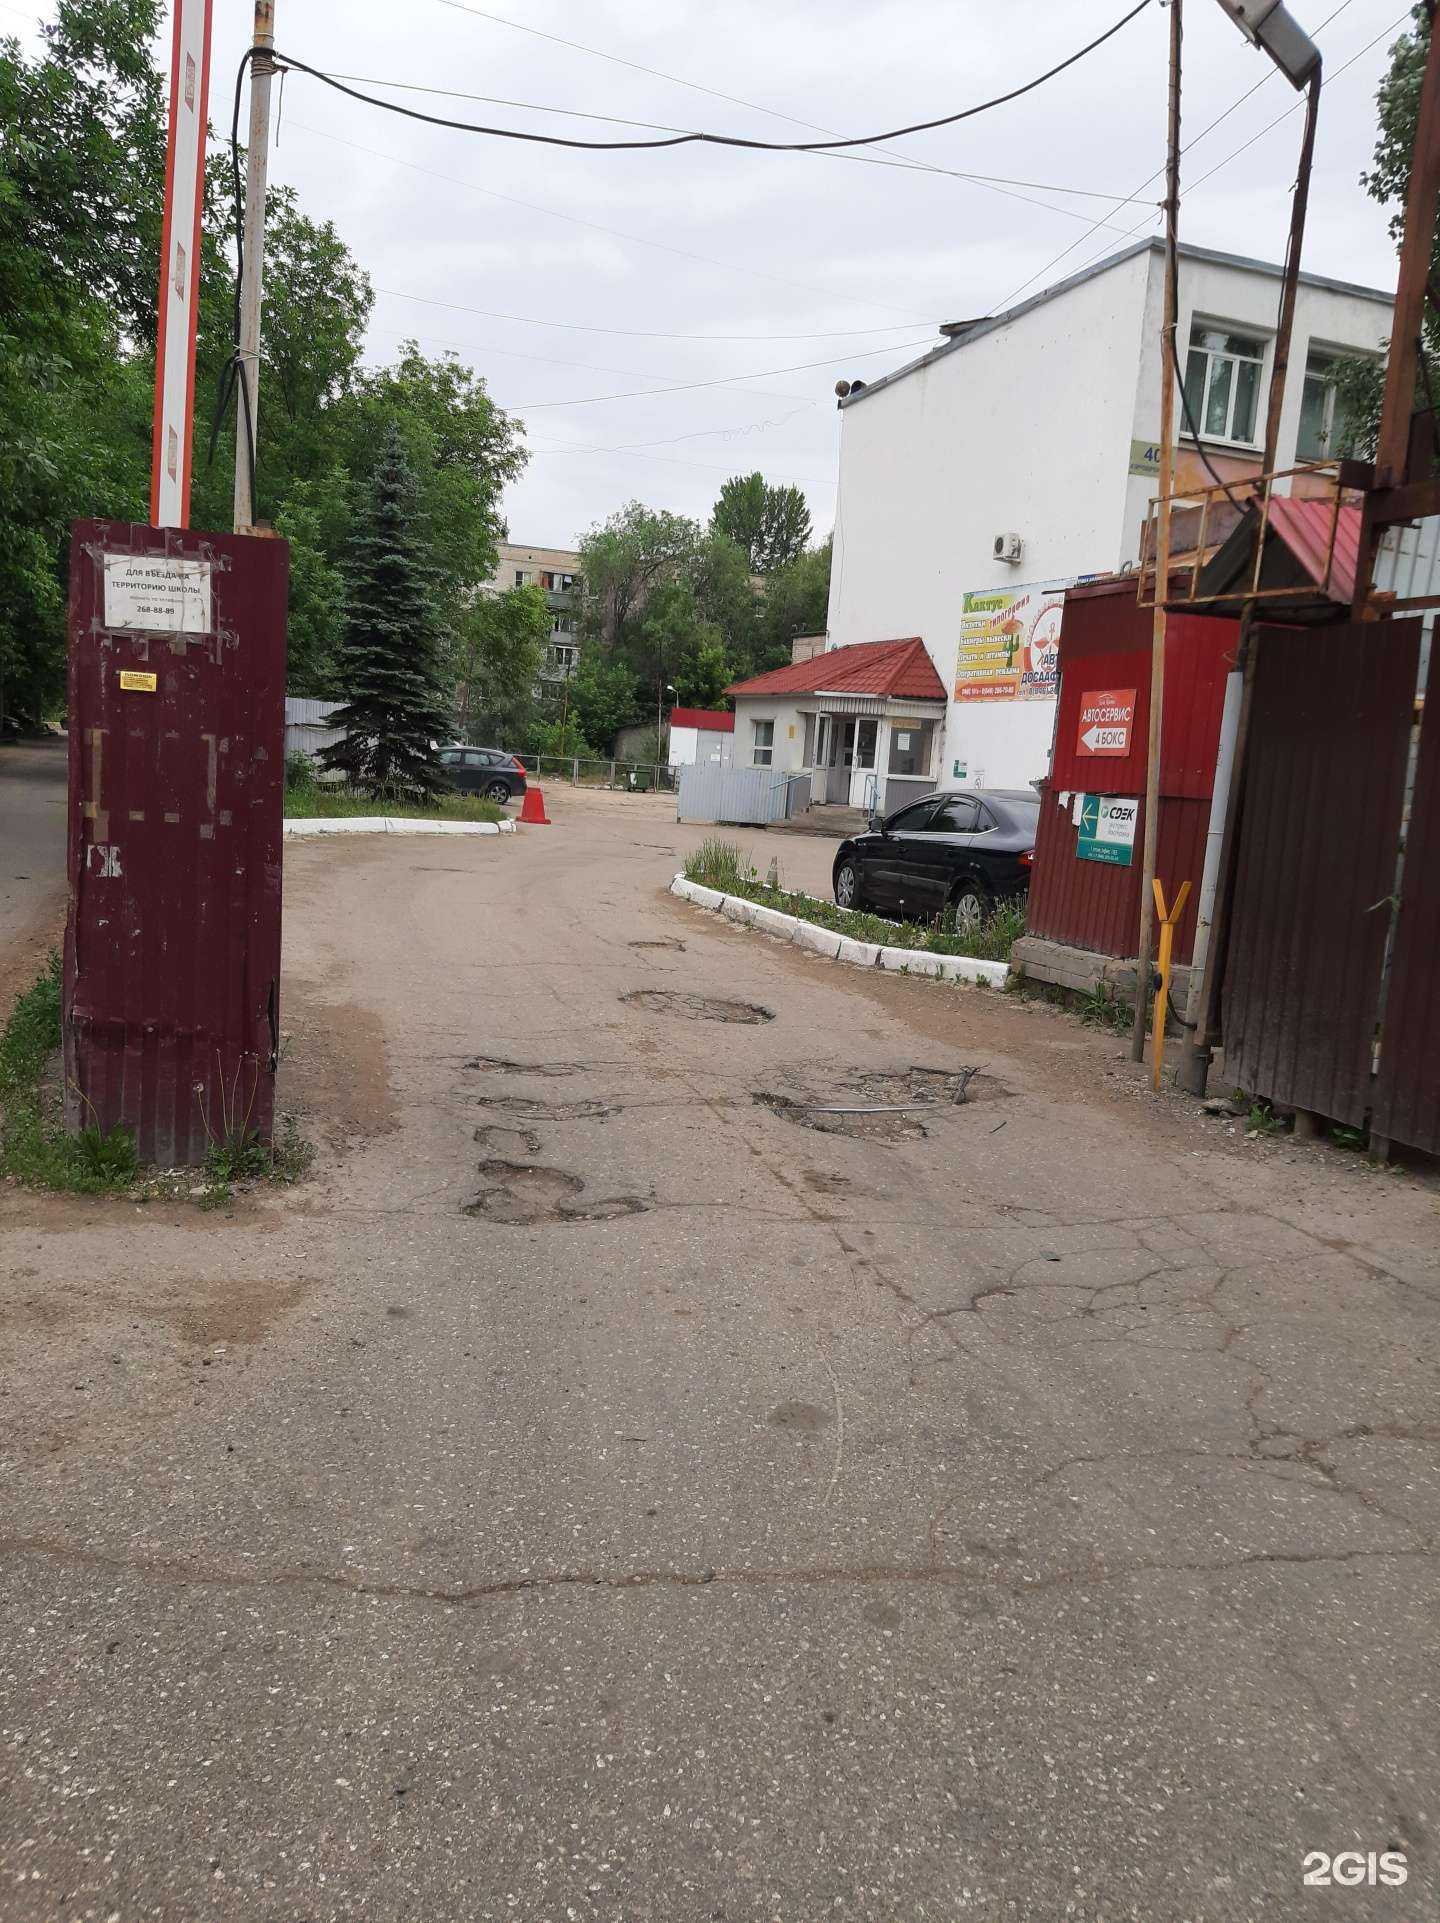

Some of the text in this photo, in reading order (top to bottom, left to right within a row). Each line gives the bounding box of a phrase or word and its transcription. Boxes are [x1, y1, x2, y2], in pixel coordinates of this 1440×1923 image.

[126, 569, 143, 577] ДЛЯ
[145, 569, 177, 580] ВЪЕЗДА
[112, 581, 200, 594] ТЕРРИТОРИЮ ШКОЛЫ
[963, 592, 1003, 613] Кактус
[1081, 706, 1131, 723] АВТОСЕРВИС
[1095, 731, 1125, 745] 4 БОКС
[1109, 806, 1136, 821] CDEK
